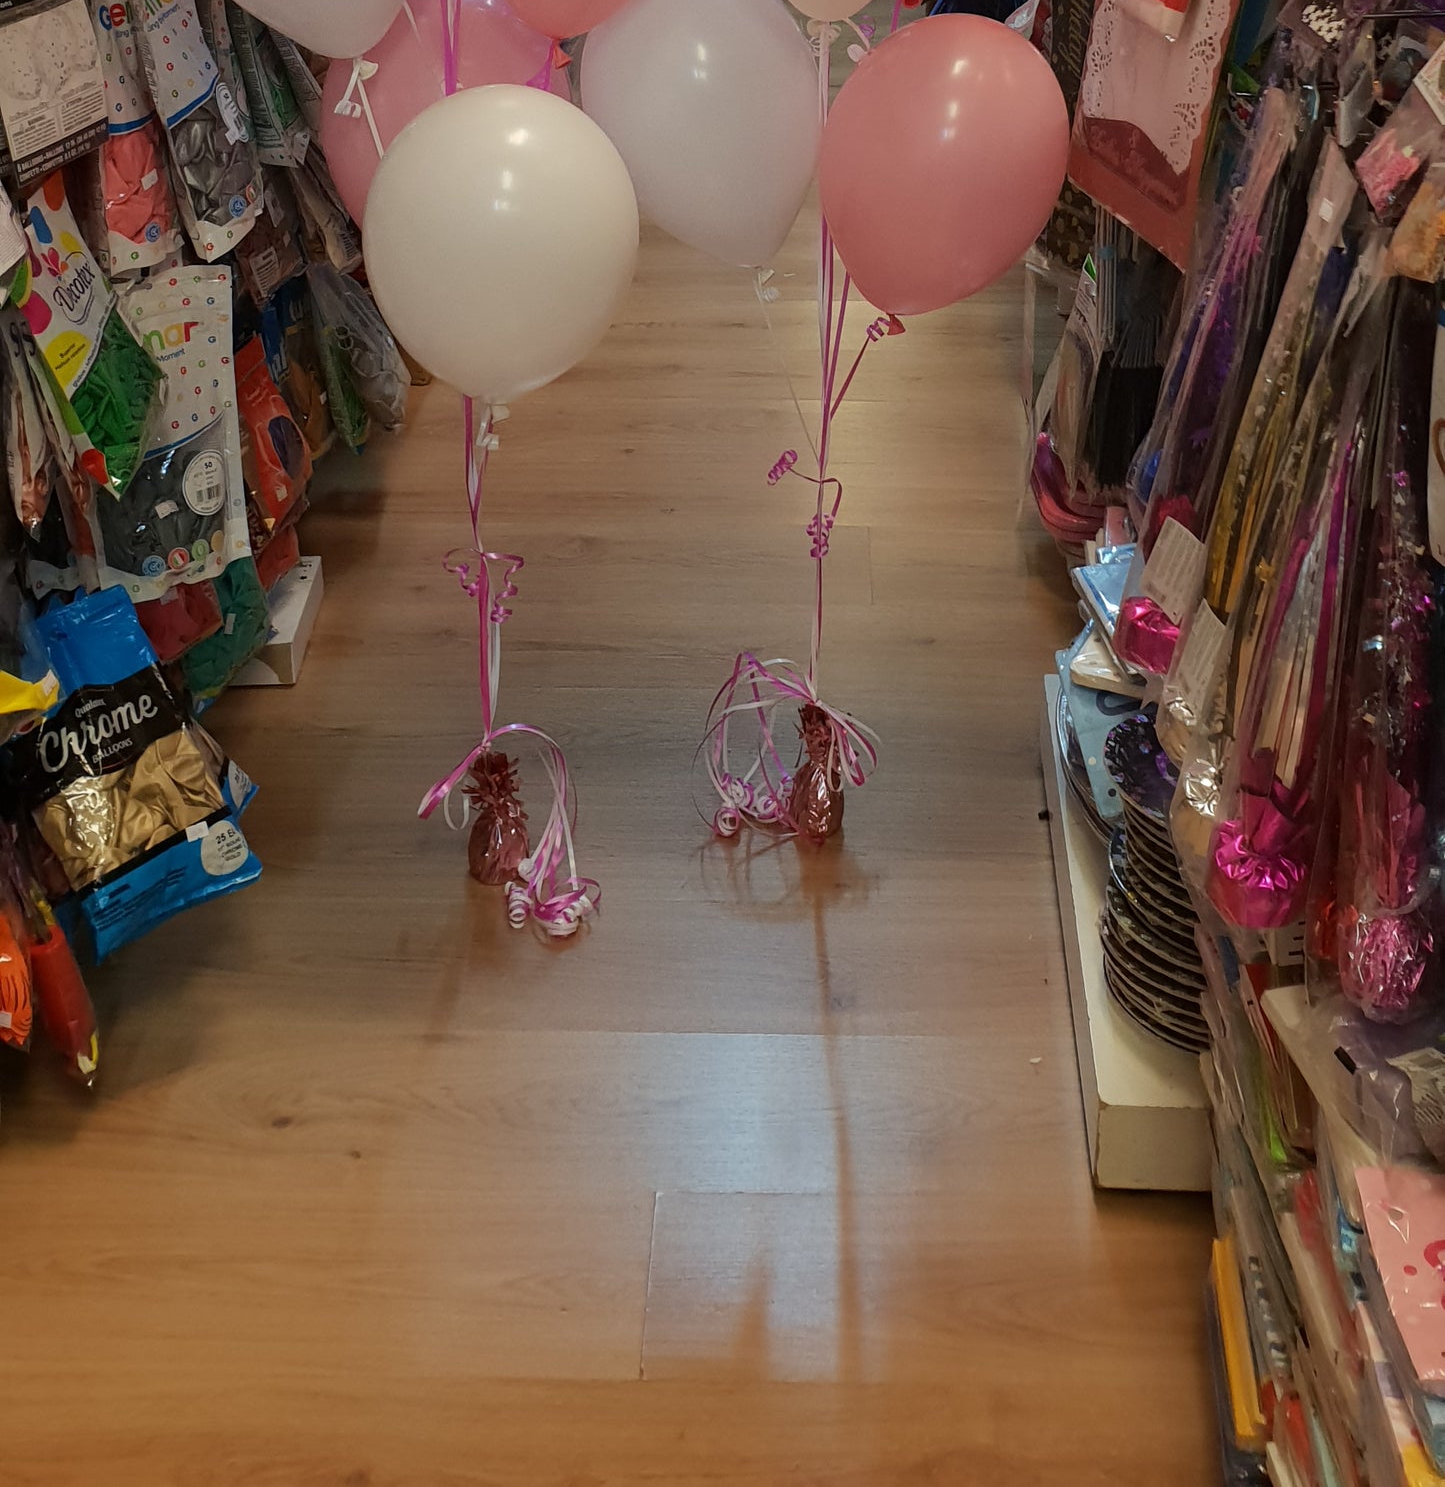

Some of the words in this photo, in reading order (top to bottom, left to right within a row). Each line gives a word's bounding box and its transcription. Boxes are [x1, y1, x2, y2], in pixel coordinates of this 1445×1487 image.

[204, 461, 213, 470] 50
[39, 694, 159, 773] Chrome
[91, 737, 134, 764] BALLOONS
[215, 833, 226, 845] 25
